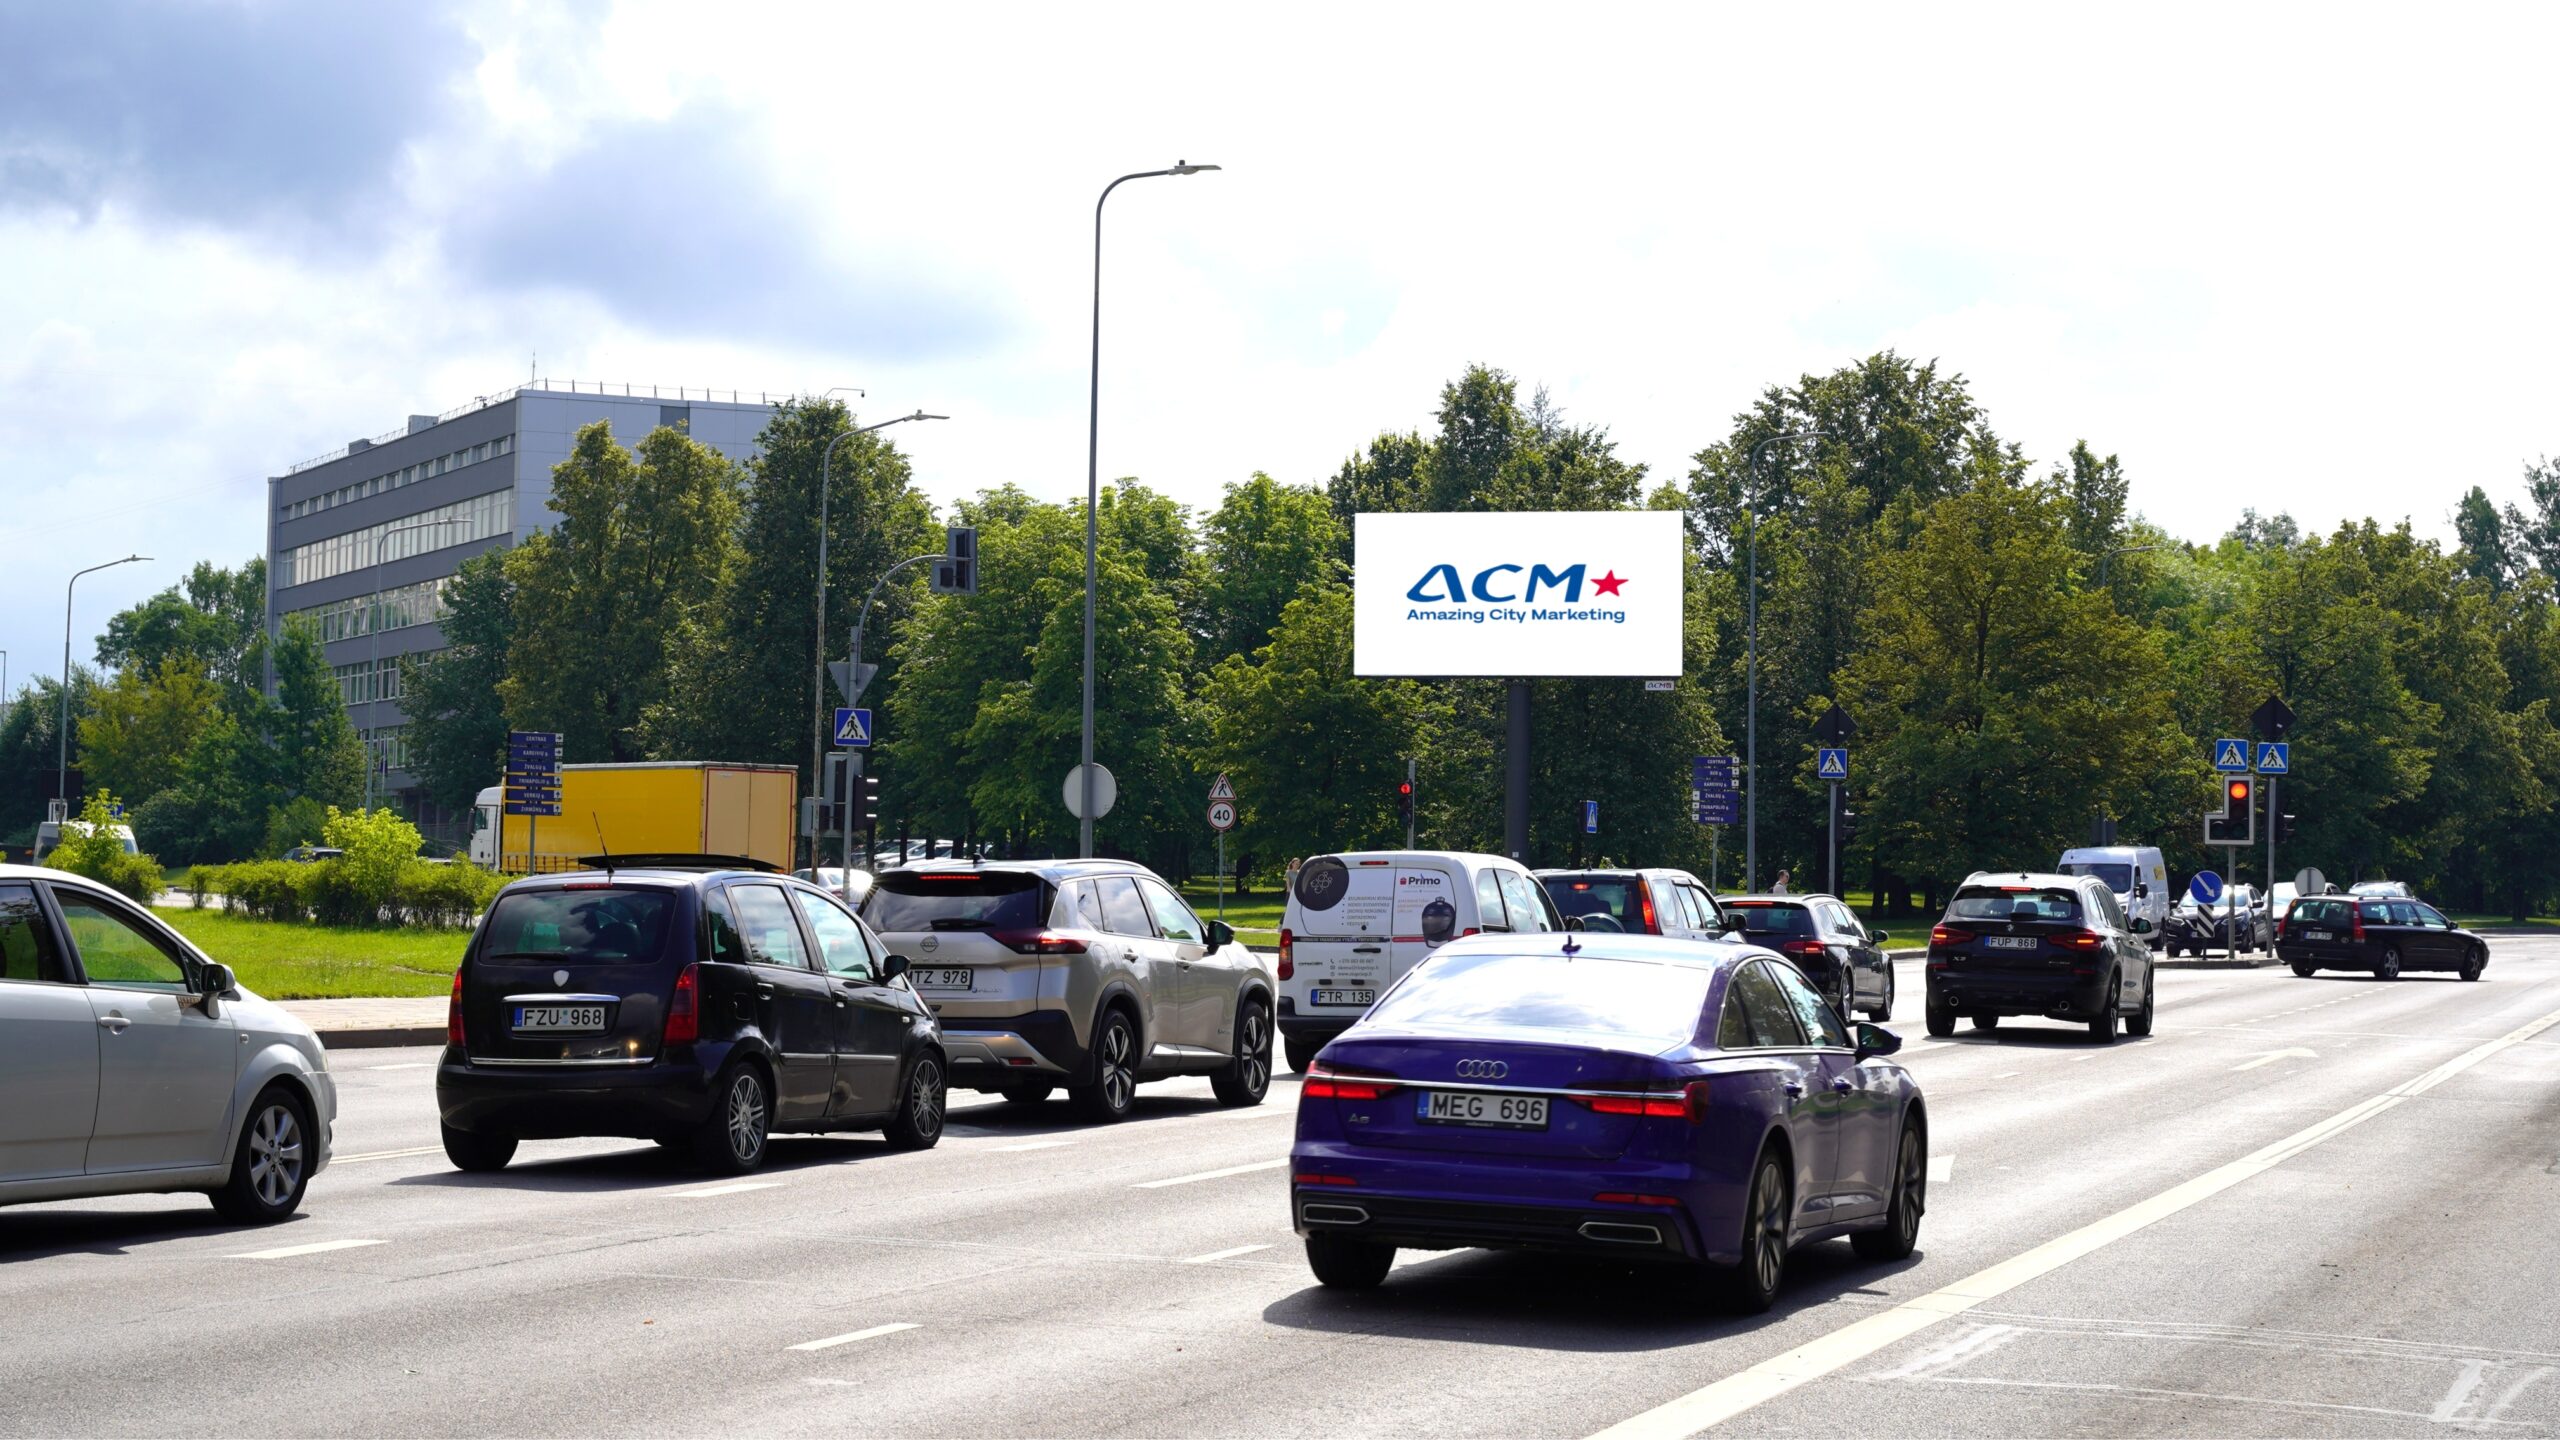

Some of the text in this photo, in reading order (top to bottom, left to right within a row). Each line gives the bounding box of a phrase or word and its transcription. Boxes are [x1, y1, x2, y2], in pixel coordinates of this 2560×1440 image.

[1406, 564, 1587, 602] ACM
[1407, 608, 1625, 623] Amazing City Marketing
[1213, 809, 1230, 821] 40
[1408, 876, 1441, 885] Primo
[1989, 937, 2036, 948] FUP 868
[904, 970, 969, 985] MTZ 978
[1318, 991, 1372, 1003] FTR 135
[524, 1009, 602, 1026] FZU 968
[1431, 1094, 1545, 1121] MEG 696
